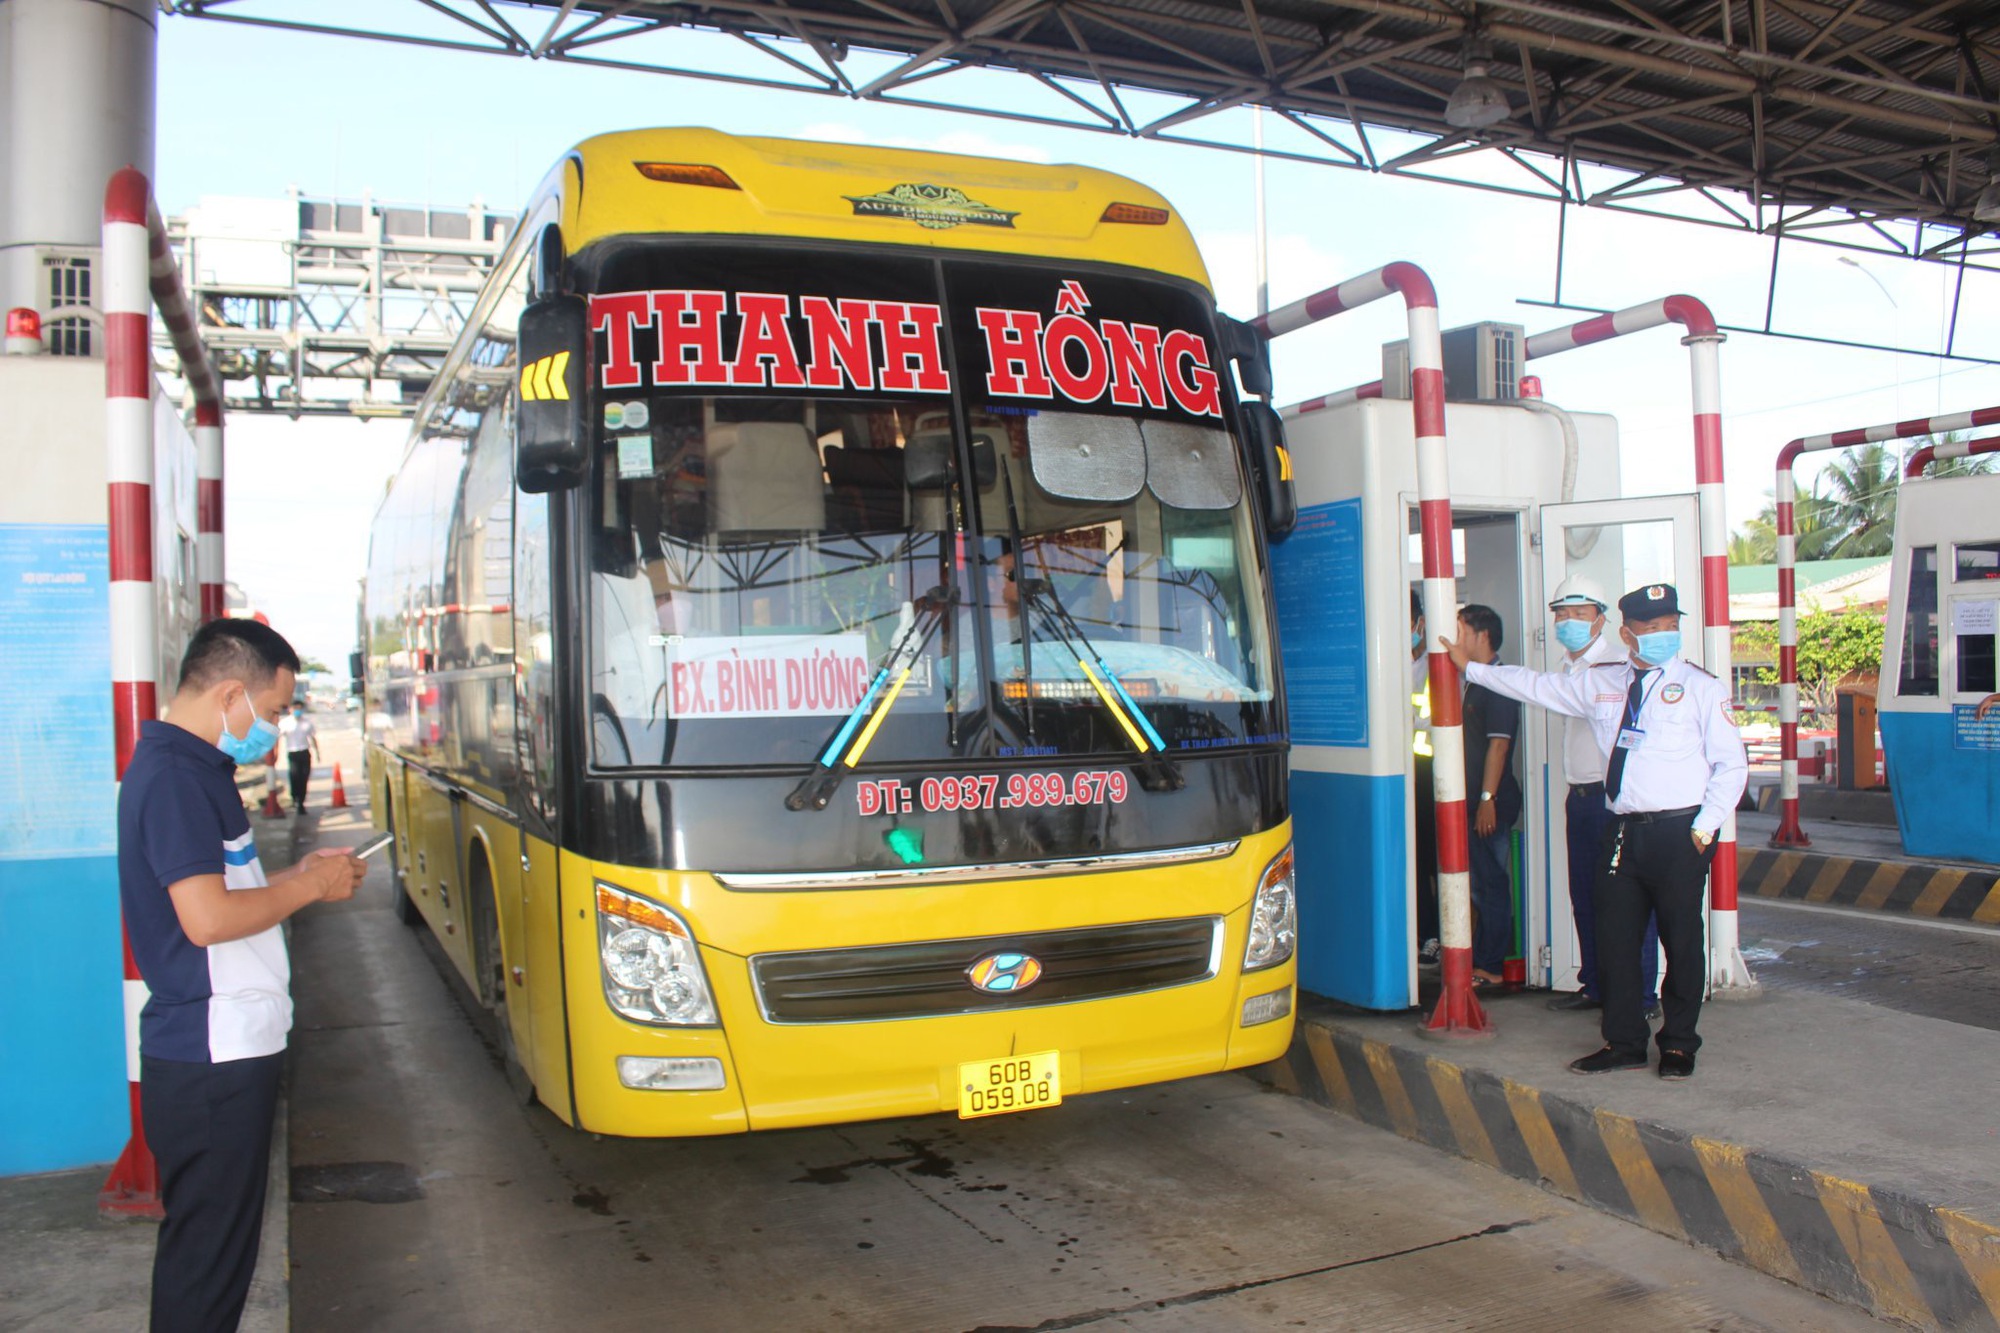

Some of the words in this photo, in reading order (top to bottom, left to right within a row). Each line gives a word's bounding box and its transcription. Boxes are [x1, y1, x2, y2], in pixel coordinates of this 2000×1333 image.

[859, 201, 1008, 222] AUTOKDOM
[587, 290, 951, 394] THANH
[976, 279, 1224, 419] HỒNG
[785, 646, 869, 711] DƯƠNG
[857, 779, 913, 815] ĐT:
[919, 770, 1128, 812] 0937.989.679
[990, 1060, 1031, 1086] 60B
[971, 1081, 1050, 1112] 059.08
